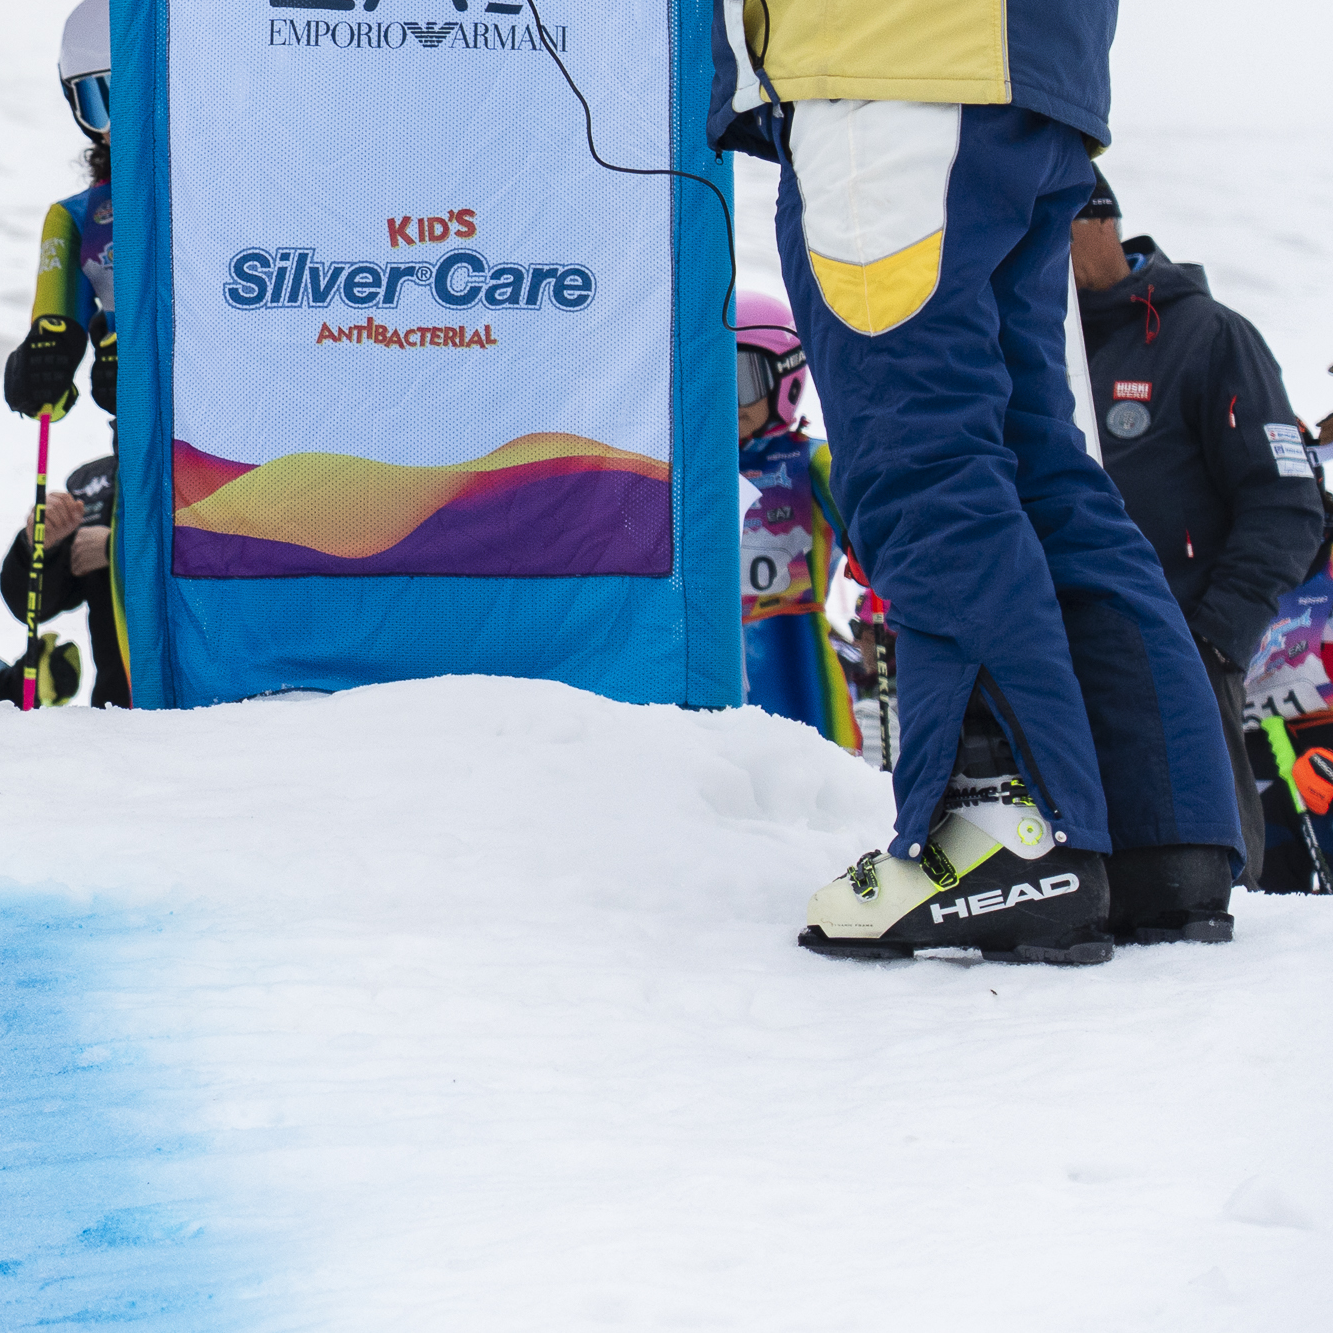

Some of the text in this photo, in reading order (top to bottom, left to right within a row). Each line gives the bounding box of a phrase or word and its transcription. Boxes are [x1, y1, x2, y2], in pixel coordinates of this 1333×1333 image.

[267, 18, 569, 53] EMPORIO ARMANI
[386, 207, 478, 249] KID'S
[316, 315, 499, 350] ANTIBACTERIAL
[776, 350, 807, 373] HEA
[929, 872, 1080, 924] HEAD
